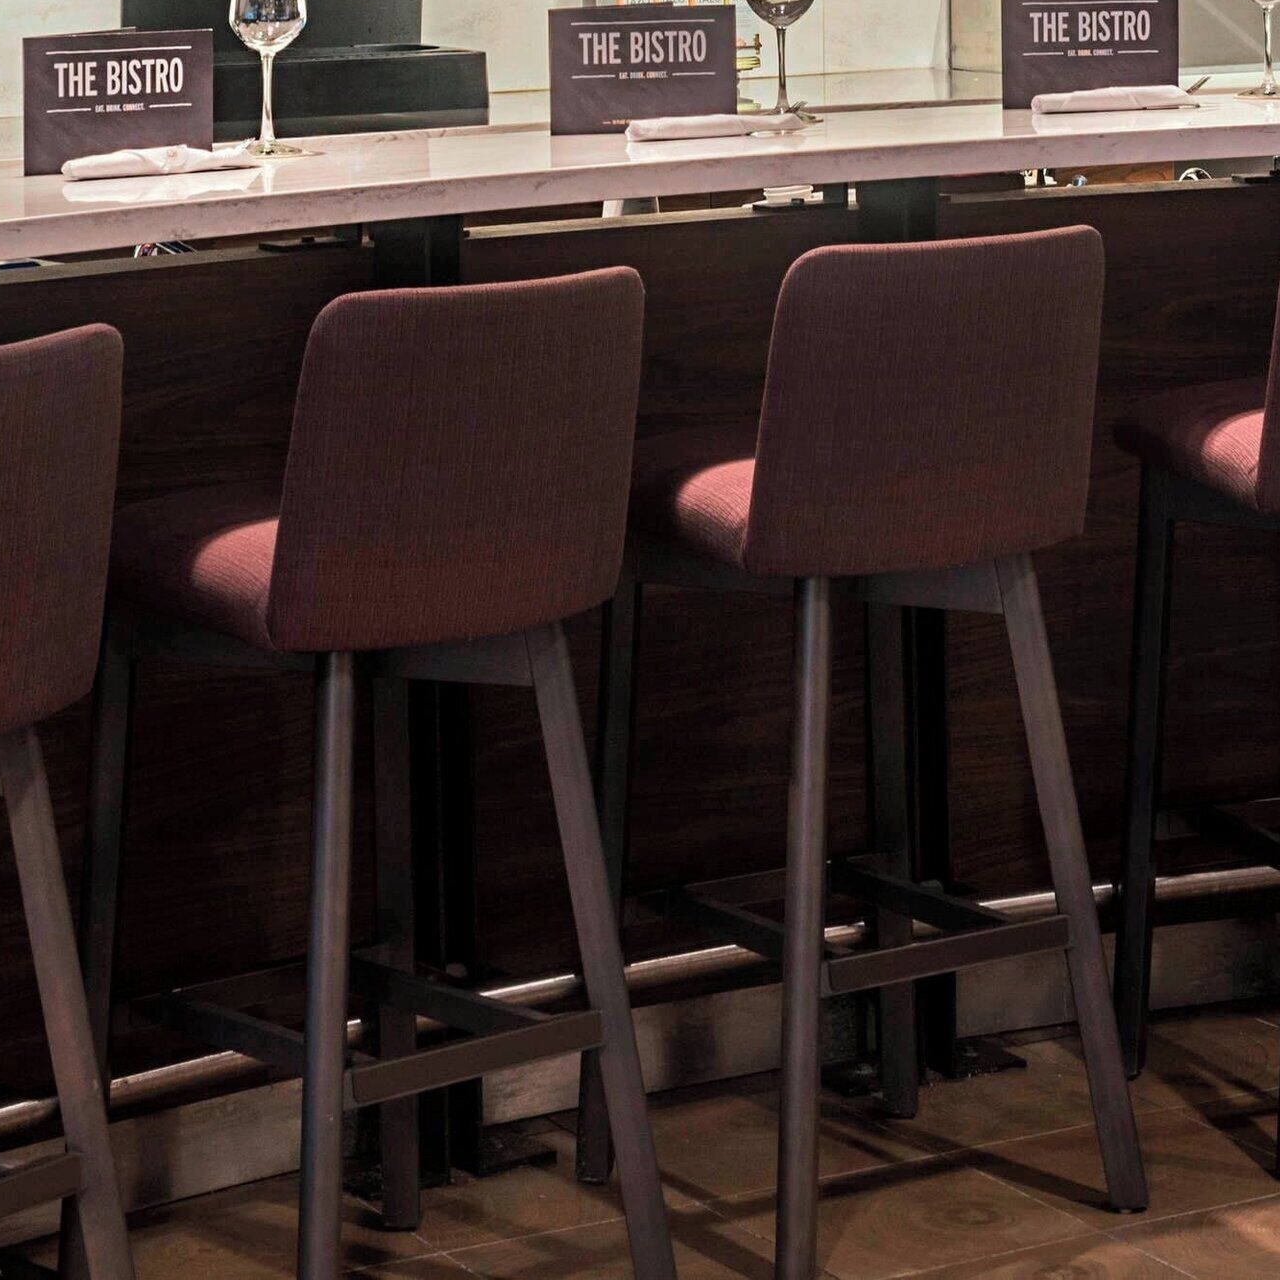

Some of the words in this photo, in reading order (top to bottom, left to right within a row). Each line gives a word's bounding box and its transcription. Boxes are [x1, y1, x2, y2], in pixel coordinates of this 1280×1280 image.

[1030, 12, 1069, 42] THE
[1078, 10, 1150, 42] BISTRO
[579, 32, 621, 65] THE
[630, 30, 707, 63] BISTRO
[54, 62, 97, 97] THE
[107, 57, 183, 95] BISTRO
[106, 104, 121, 112] DRINK.
[122, 103, 145, 111] CONNECT.
